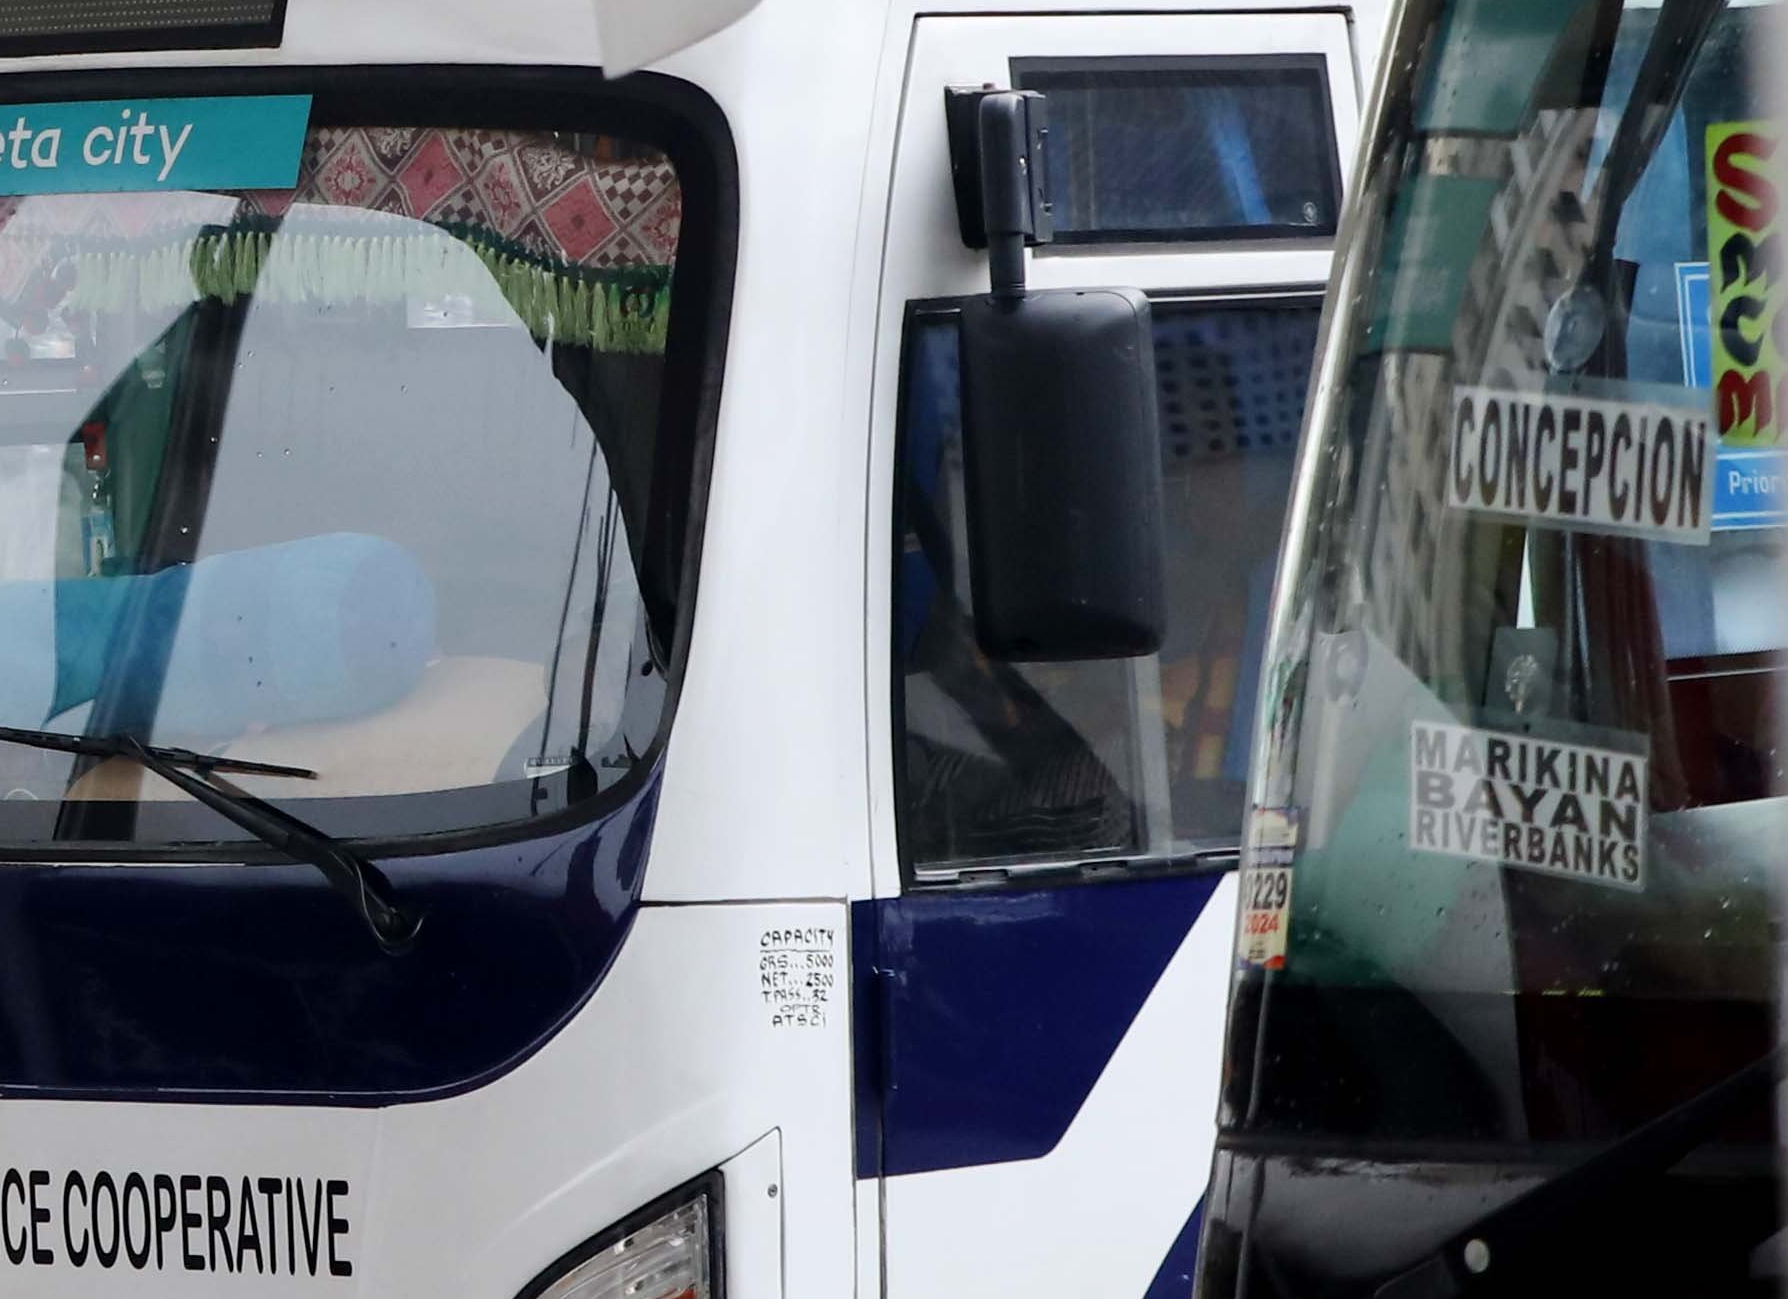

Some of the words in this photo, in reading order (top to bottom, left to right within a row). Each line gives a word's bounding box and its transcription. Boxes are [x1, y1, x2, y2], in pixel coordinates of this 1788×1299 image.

[81, 108, 194, 182] city
[1452, 395, 1709, 531] CONCEPCION
[1729, 470, 1777, 496] Prior
[1415, 725, 1642, 805] MARIKINA
[1414, 768, 1637, 842] BAYAN
[1415, 806, 1641, 882] RIVERBANKS
[760, 927, 835, 948] CAPACITY
[62, 1169, 354, 1278] COOPERATIVE
